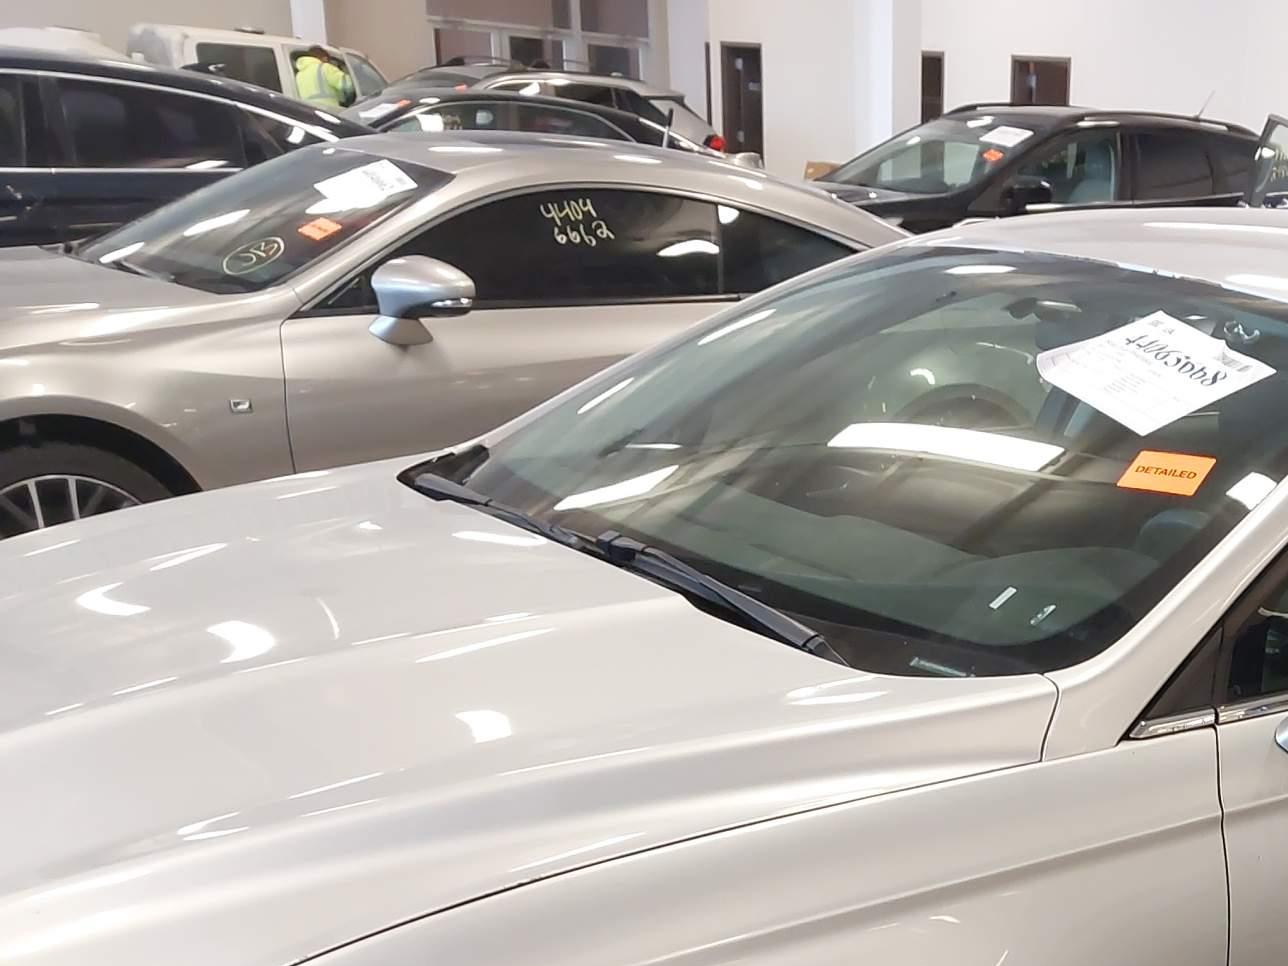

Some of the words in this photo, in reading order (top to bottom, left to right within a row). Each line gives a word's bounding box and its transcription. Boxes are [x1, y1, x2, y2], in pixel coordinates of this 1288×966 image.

[540, 198, 597, 226] 4404
[554, 220, 615, 247] 6662
[1134, 464, 1198, 481] DETAILED
